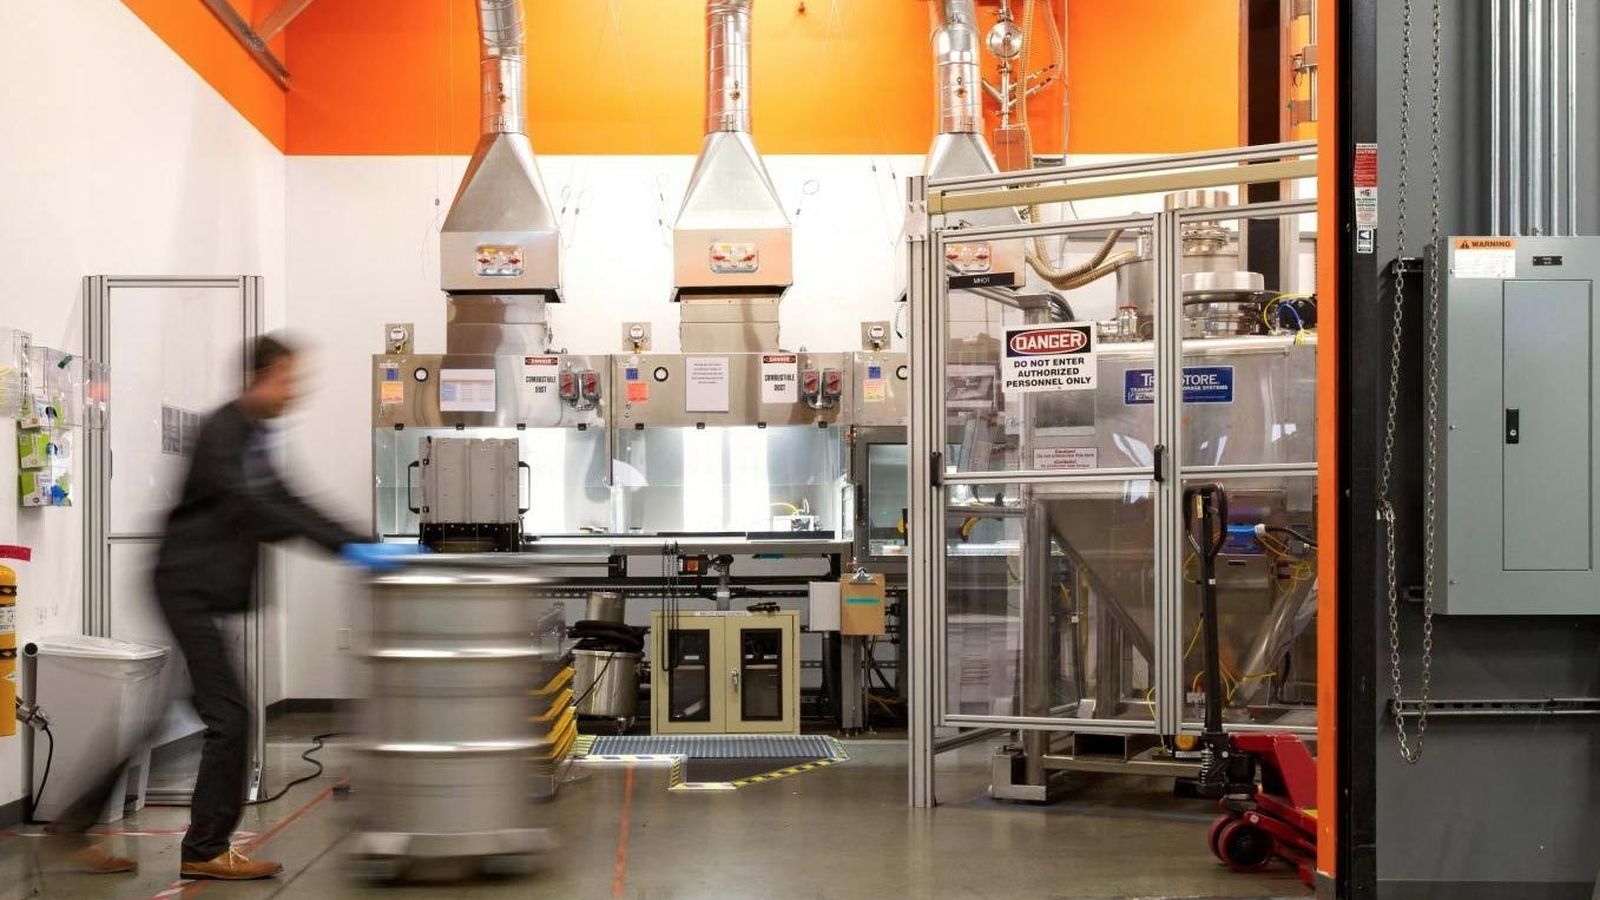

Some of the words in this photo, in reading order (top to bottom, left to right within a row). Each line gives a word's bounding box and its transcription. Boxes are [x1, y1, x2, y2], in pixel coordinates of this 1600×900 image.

[1471, 240, 1511, 248] WARNING
[1015, 333, 1082, 350] DANGER
[1014, 360, 1028, 368] DO
[1030, 359, 1049, 367] NOT
[1053, 357, 1085, 366] ENTER
[1018, 367, 1079, 377] AUTHORIZED
[1006, 377, 1064, 388] PERSONNEL
[1066, 376, 1092, 385] ONLY
